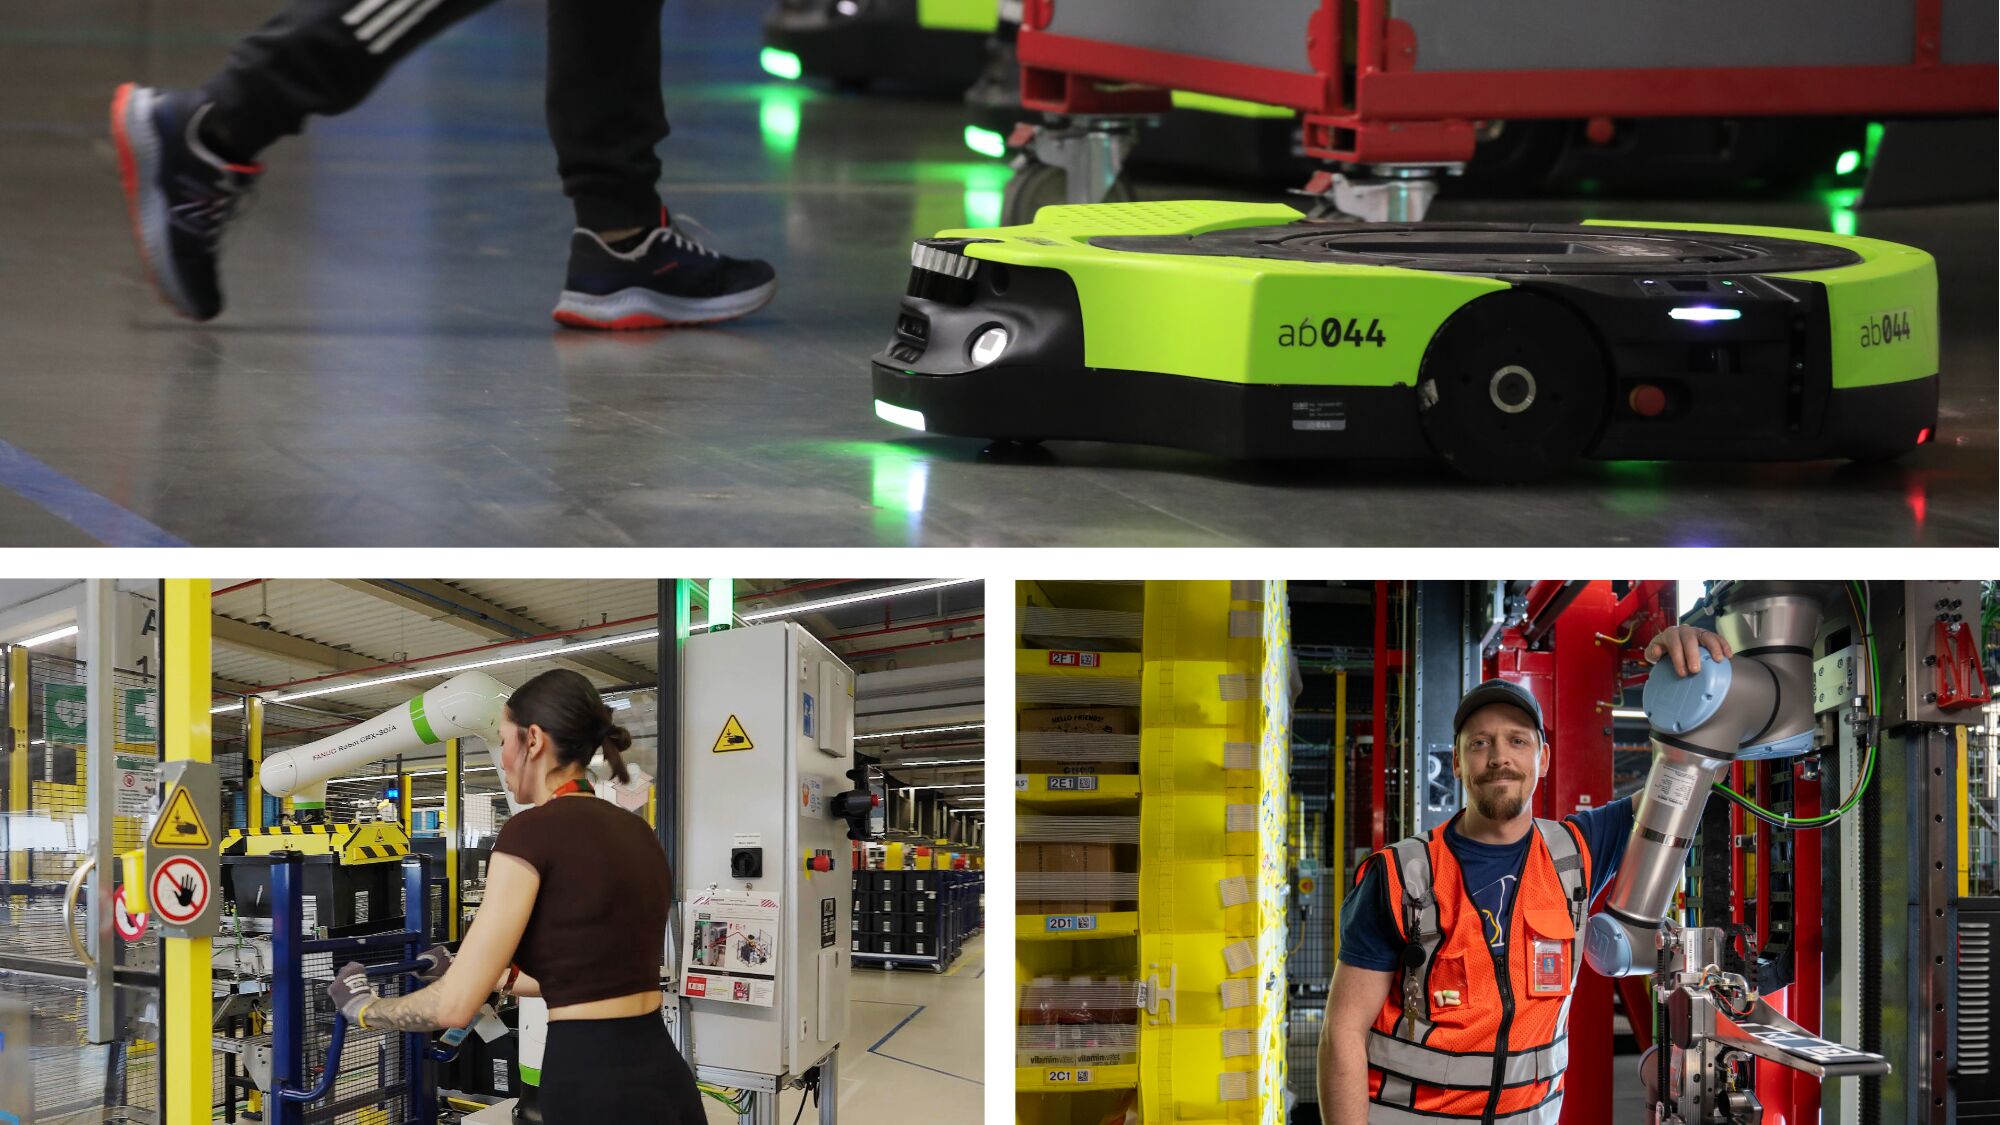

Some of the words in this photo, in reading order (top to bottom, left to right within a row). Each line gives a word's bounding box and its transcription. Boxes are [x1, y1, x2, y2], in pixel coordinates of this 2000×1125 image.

[1860, 311, 1910, 348] ab044
[136, 656, 148, 683] 1
[312, 748, 337, 761] FANUC
[338, 740, 360, 752] Robot
[1050, 919, 1067, 928] 2D
[1049, 1071, 1066, 1081] 2C
